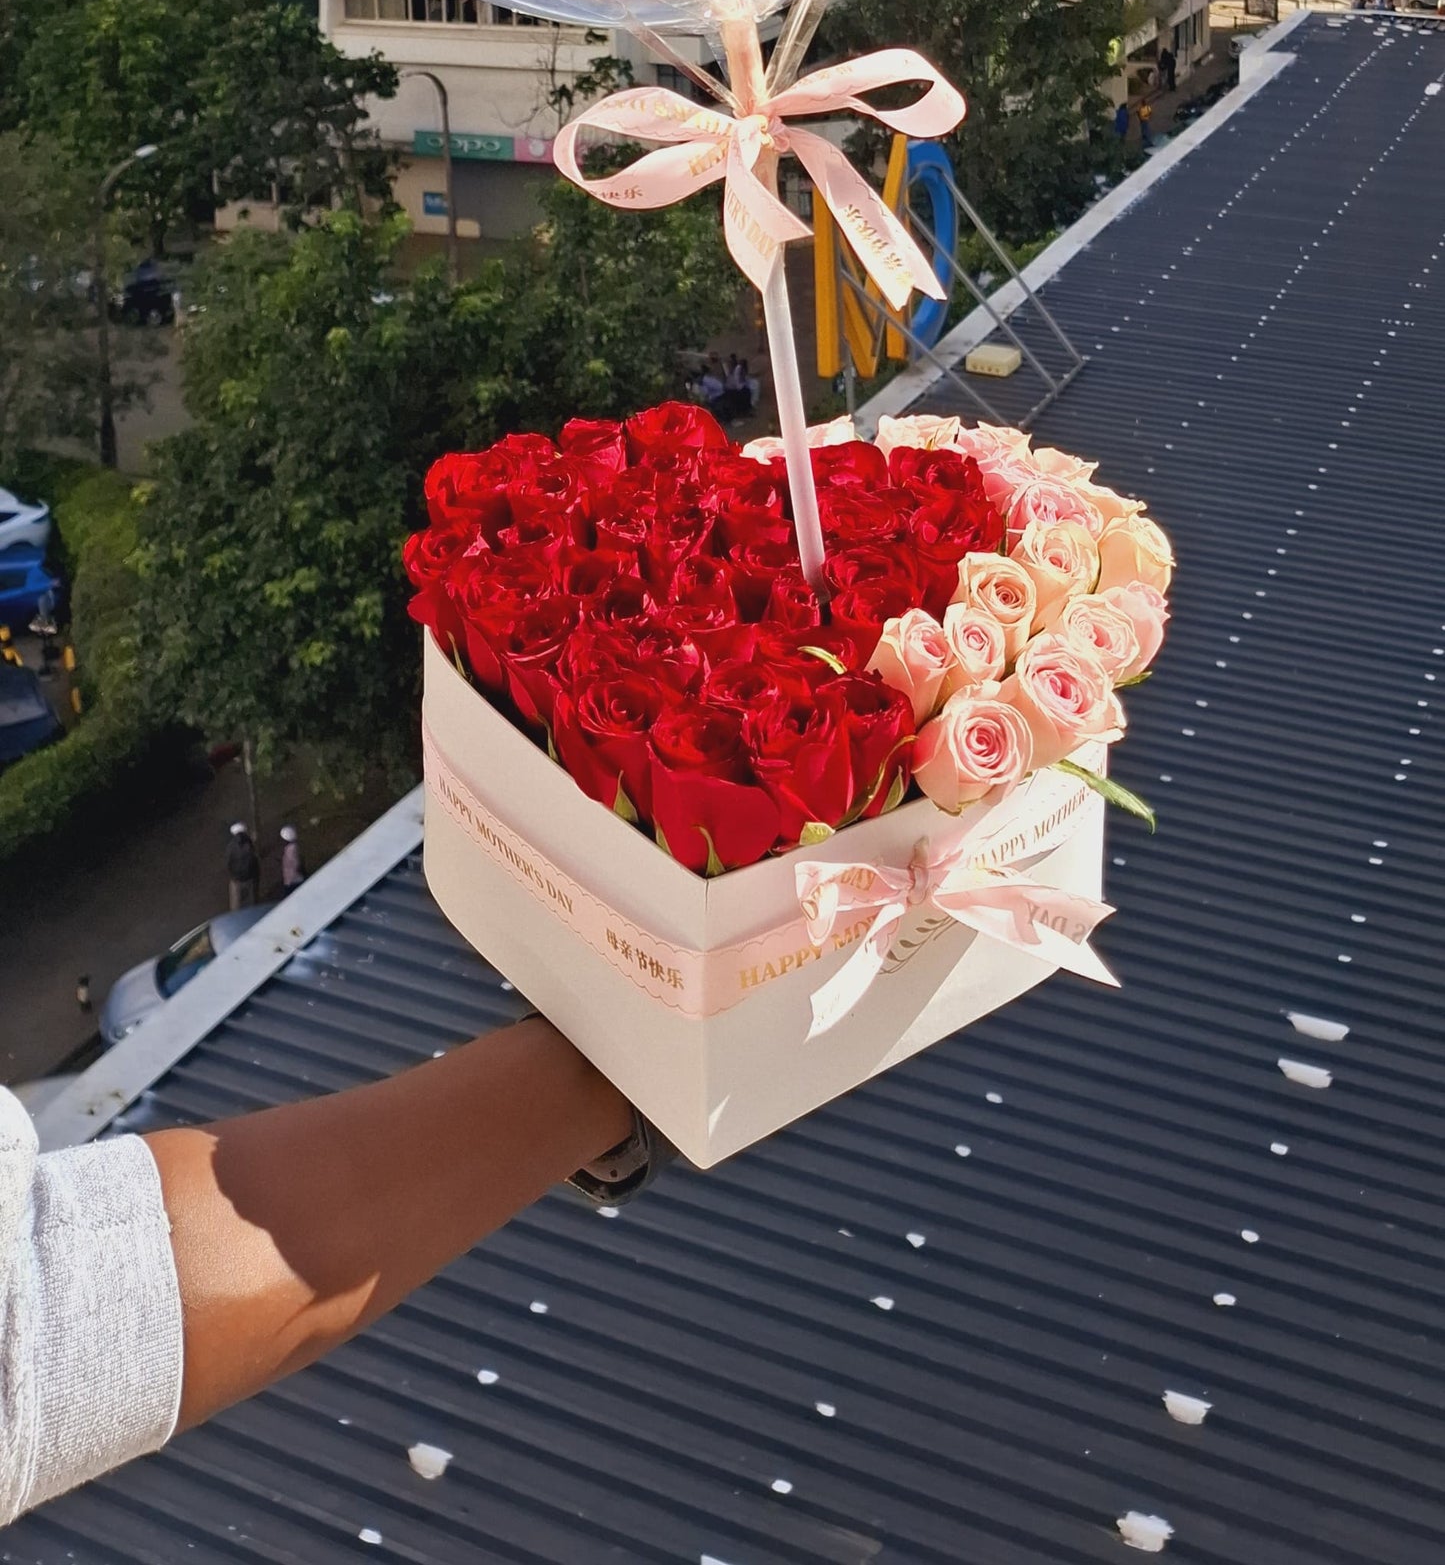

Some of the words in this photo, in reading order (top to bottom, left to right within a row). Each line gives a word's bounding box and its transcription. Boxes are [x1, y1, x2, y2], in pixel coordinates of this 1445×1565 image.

[438, 774, 472, 825] HAPPY
[475, 815, 544, 889] MOTHER'S
[546, 879, 574, 916] DAY
[1032, 785, 1089, 845] MOTHER
[605, 927, 685, 990] 母亲节快乐
[739, 944, 822, 989] HAPPY
